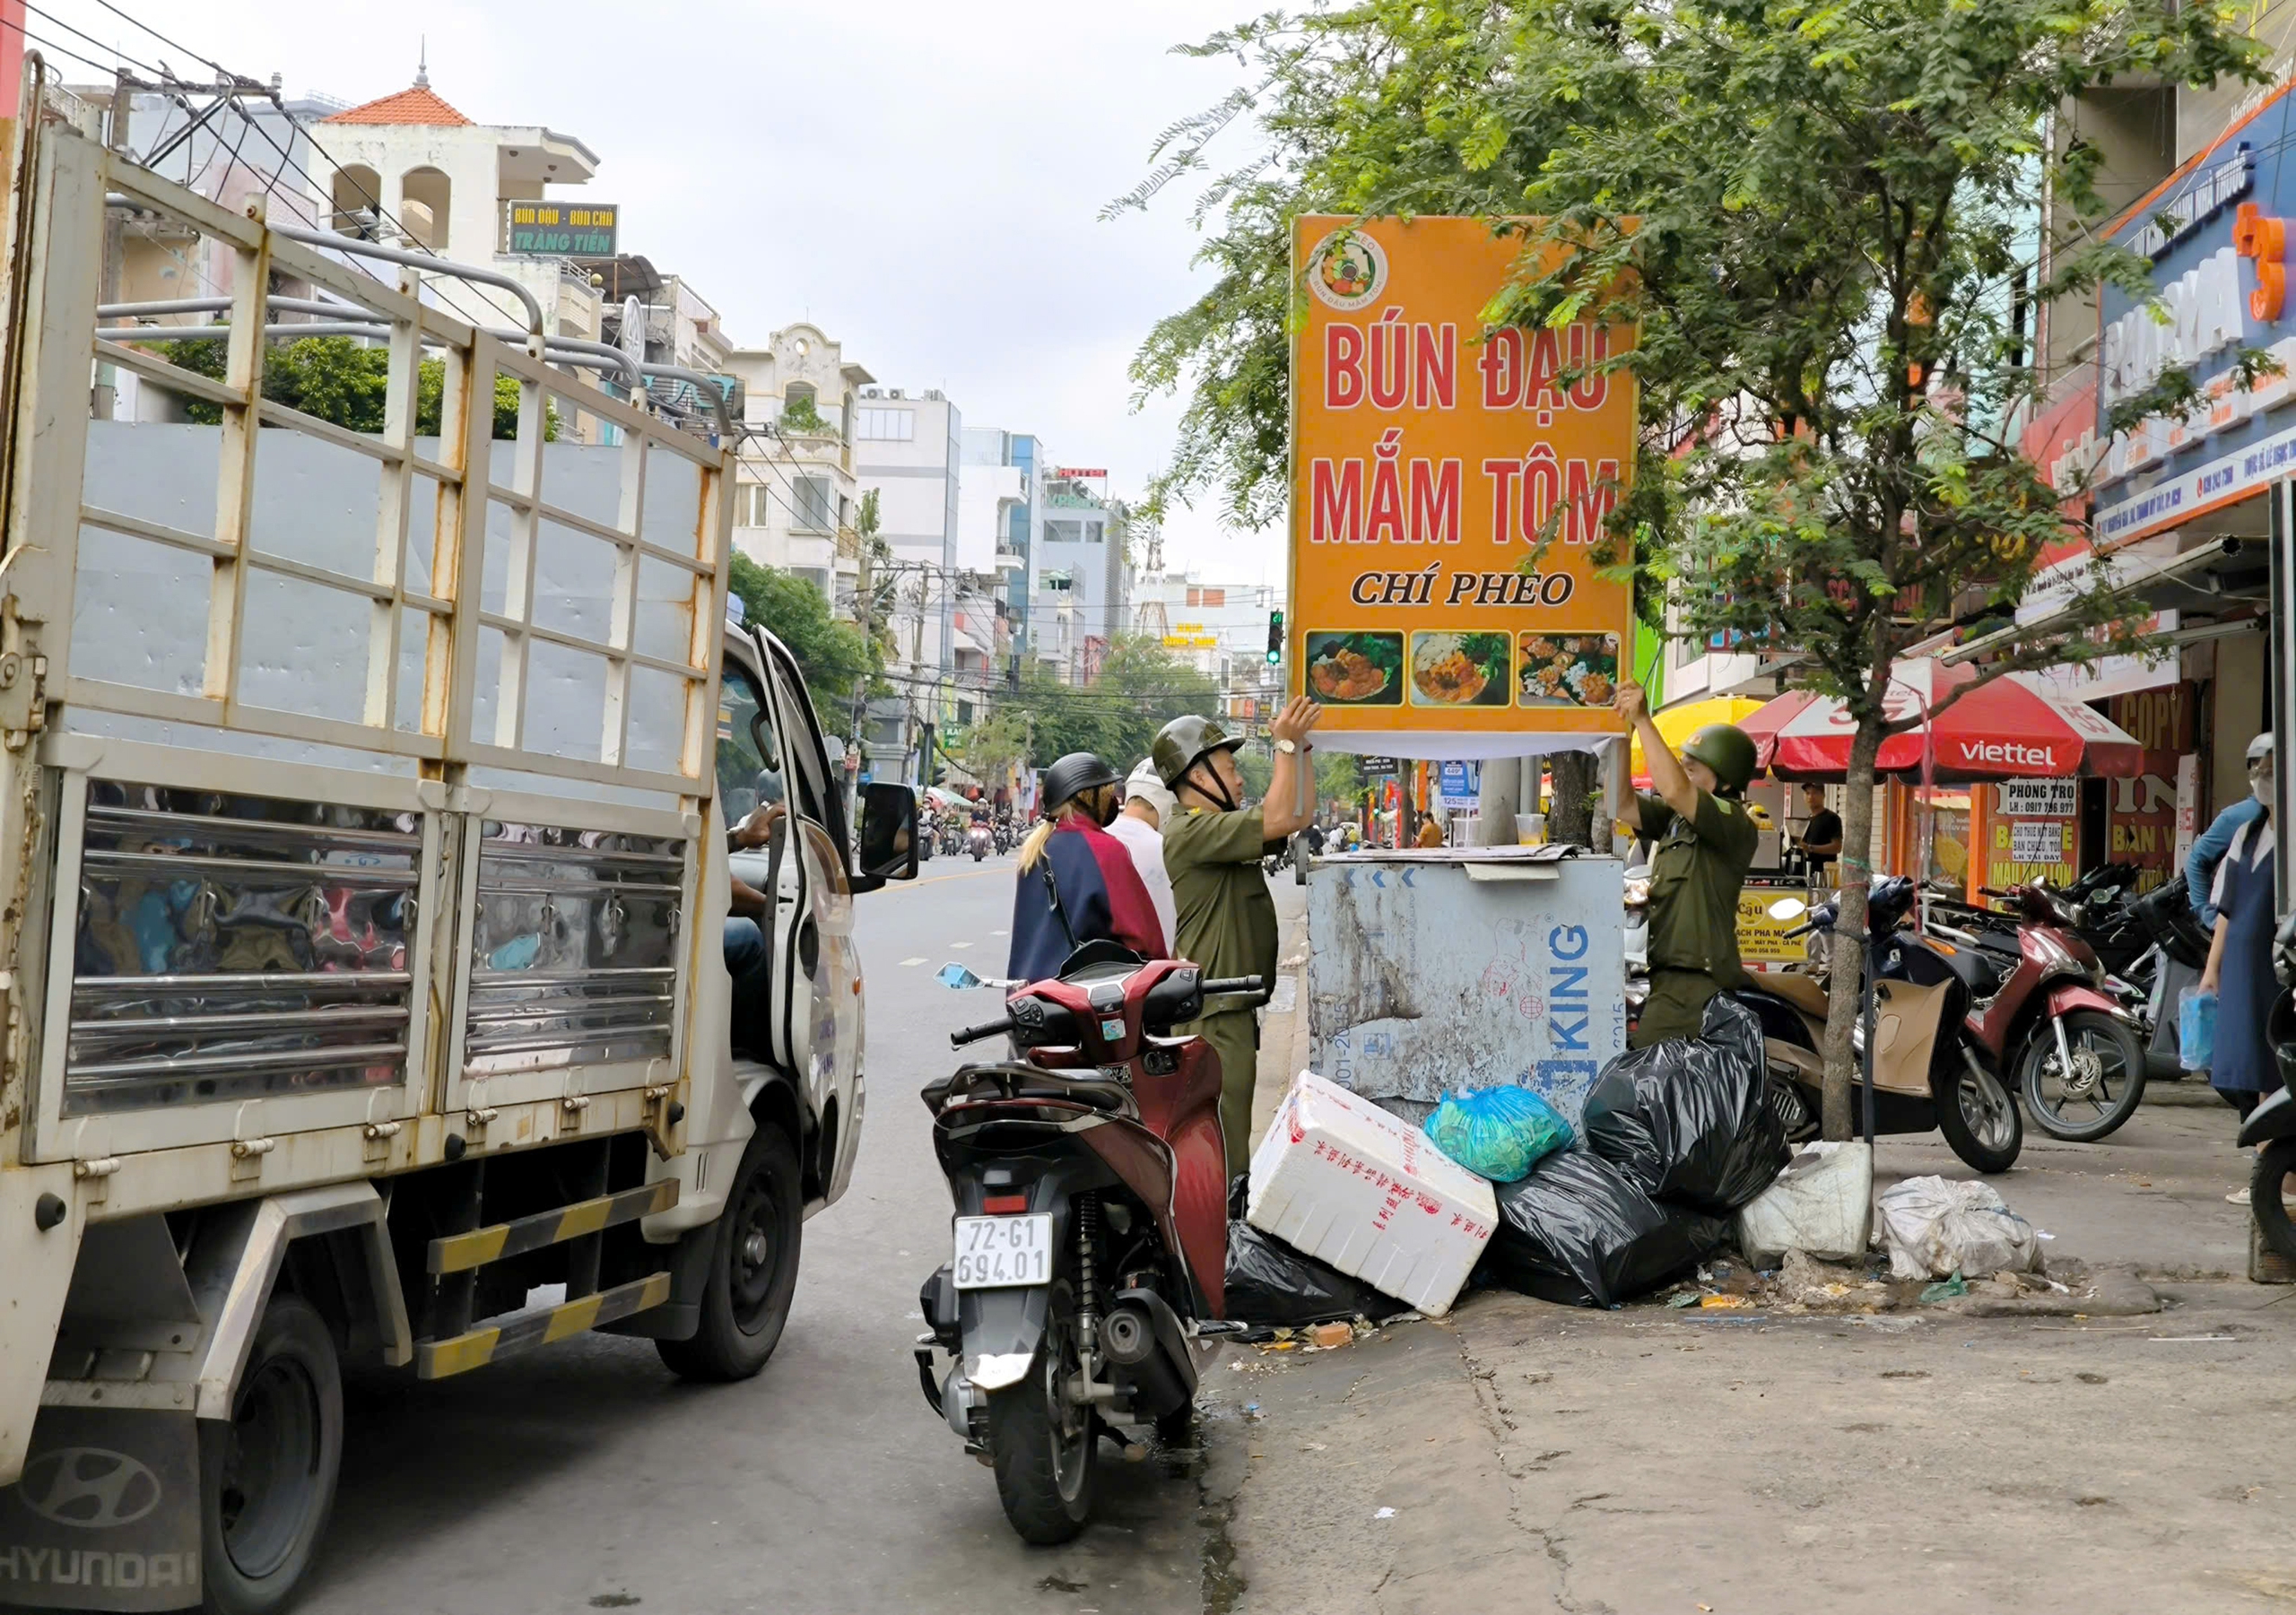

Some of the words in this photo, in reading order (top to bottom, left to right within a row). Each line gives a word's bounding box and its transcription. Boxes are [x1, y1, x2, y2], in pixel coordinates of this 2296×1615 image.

[515, 228, 570, 251] TRÀNG
[574, 228, 611, 252] TIỀN
[1325, 307, 1457, 410] BÚN
[1310, 428, 1462, 544] MẮM
[1483, 442, 1619, 544] TÔM
[1351, 560, 1442, 606] CHÍ
[2121, 691, 2184, 750] COPY
[1960, 740, 2057, 766] viettel
[2009, 780, 2047, 798] PHÒNG
[2050, 785, 2074, 803] TRỌ
[1993, 858, 2019, 886] MÀU
[1549, 924, 1589, 1050] KING
[970, 1219, 1034, 1251] 72-G1
[957, 1249, 1043, 1283] 694.01
